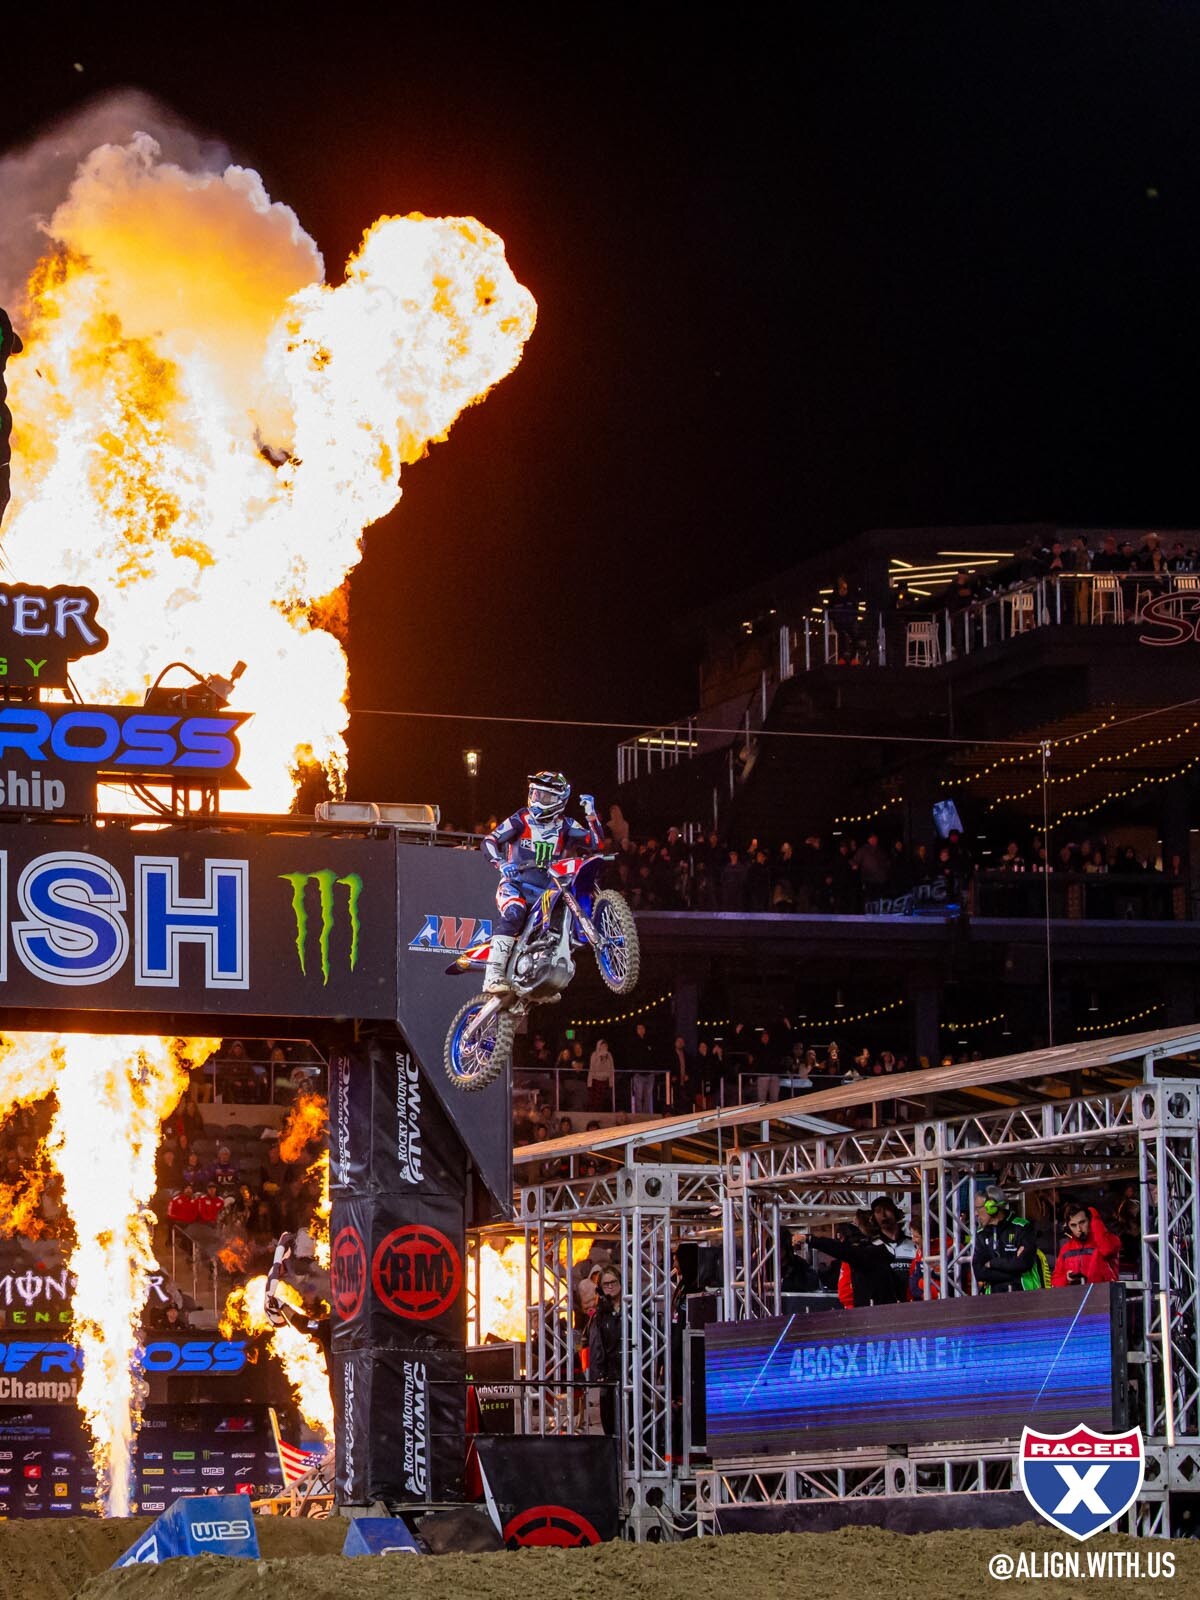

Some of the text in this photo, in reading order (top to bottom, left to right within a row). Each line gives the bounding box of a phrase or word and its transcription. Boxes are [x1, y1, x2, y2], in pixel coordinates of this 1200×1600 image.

[396, 1052, 408, 1162] ROCKY MOUNTAIN
[390, 1252, 444, 1292] RM
[789, 1343, 860, 1383] 450SX
[866, 1337, 928, 1377] MAIN
[402, 1360, 414, 1474] ROCKY MOUNTAIN
[192, 1520, 250, 1541] WPS
